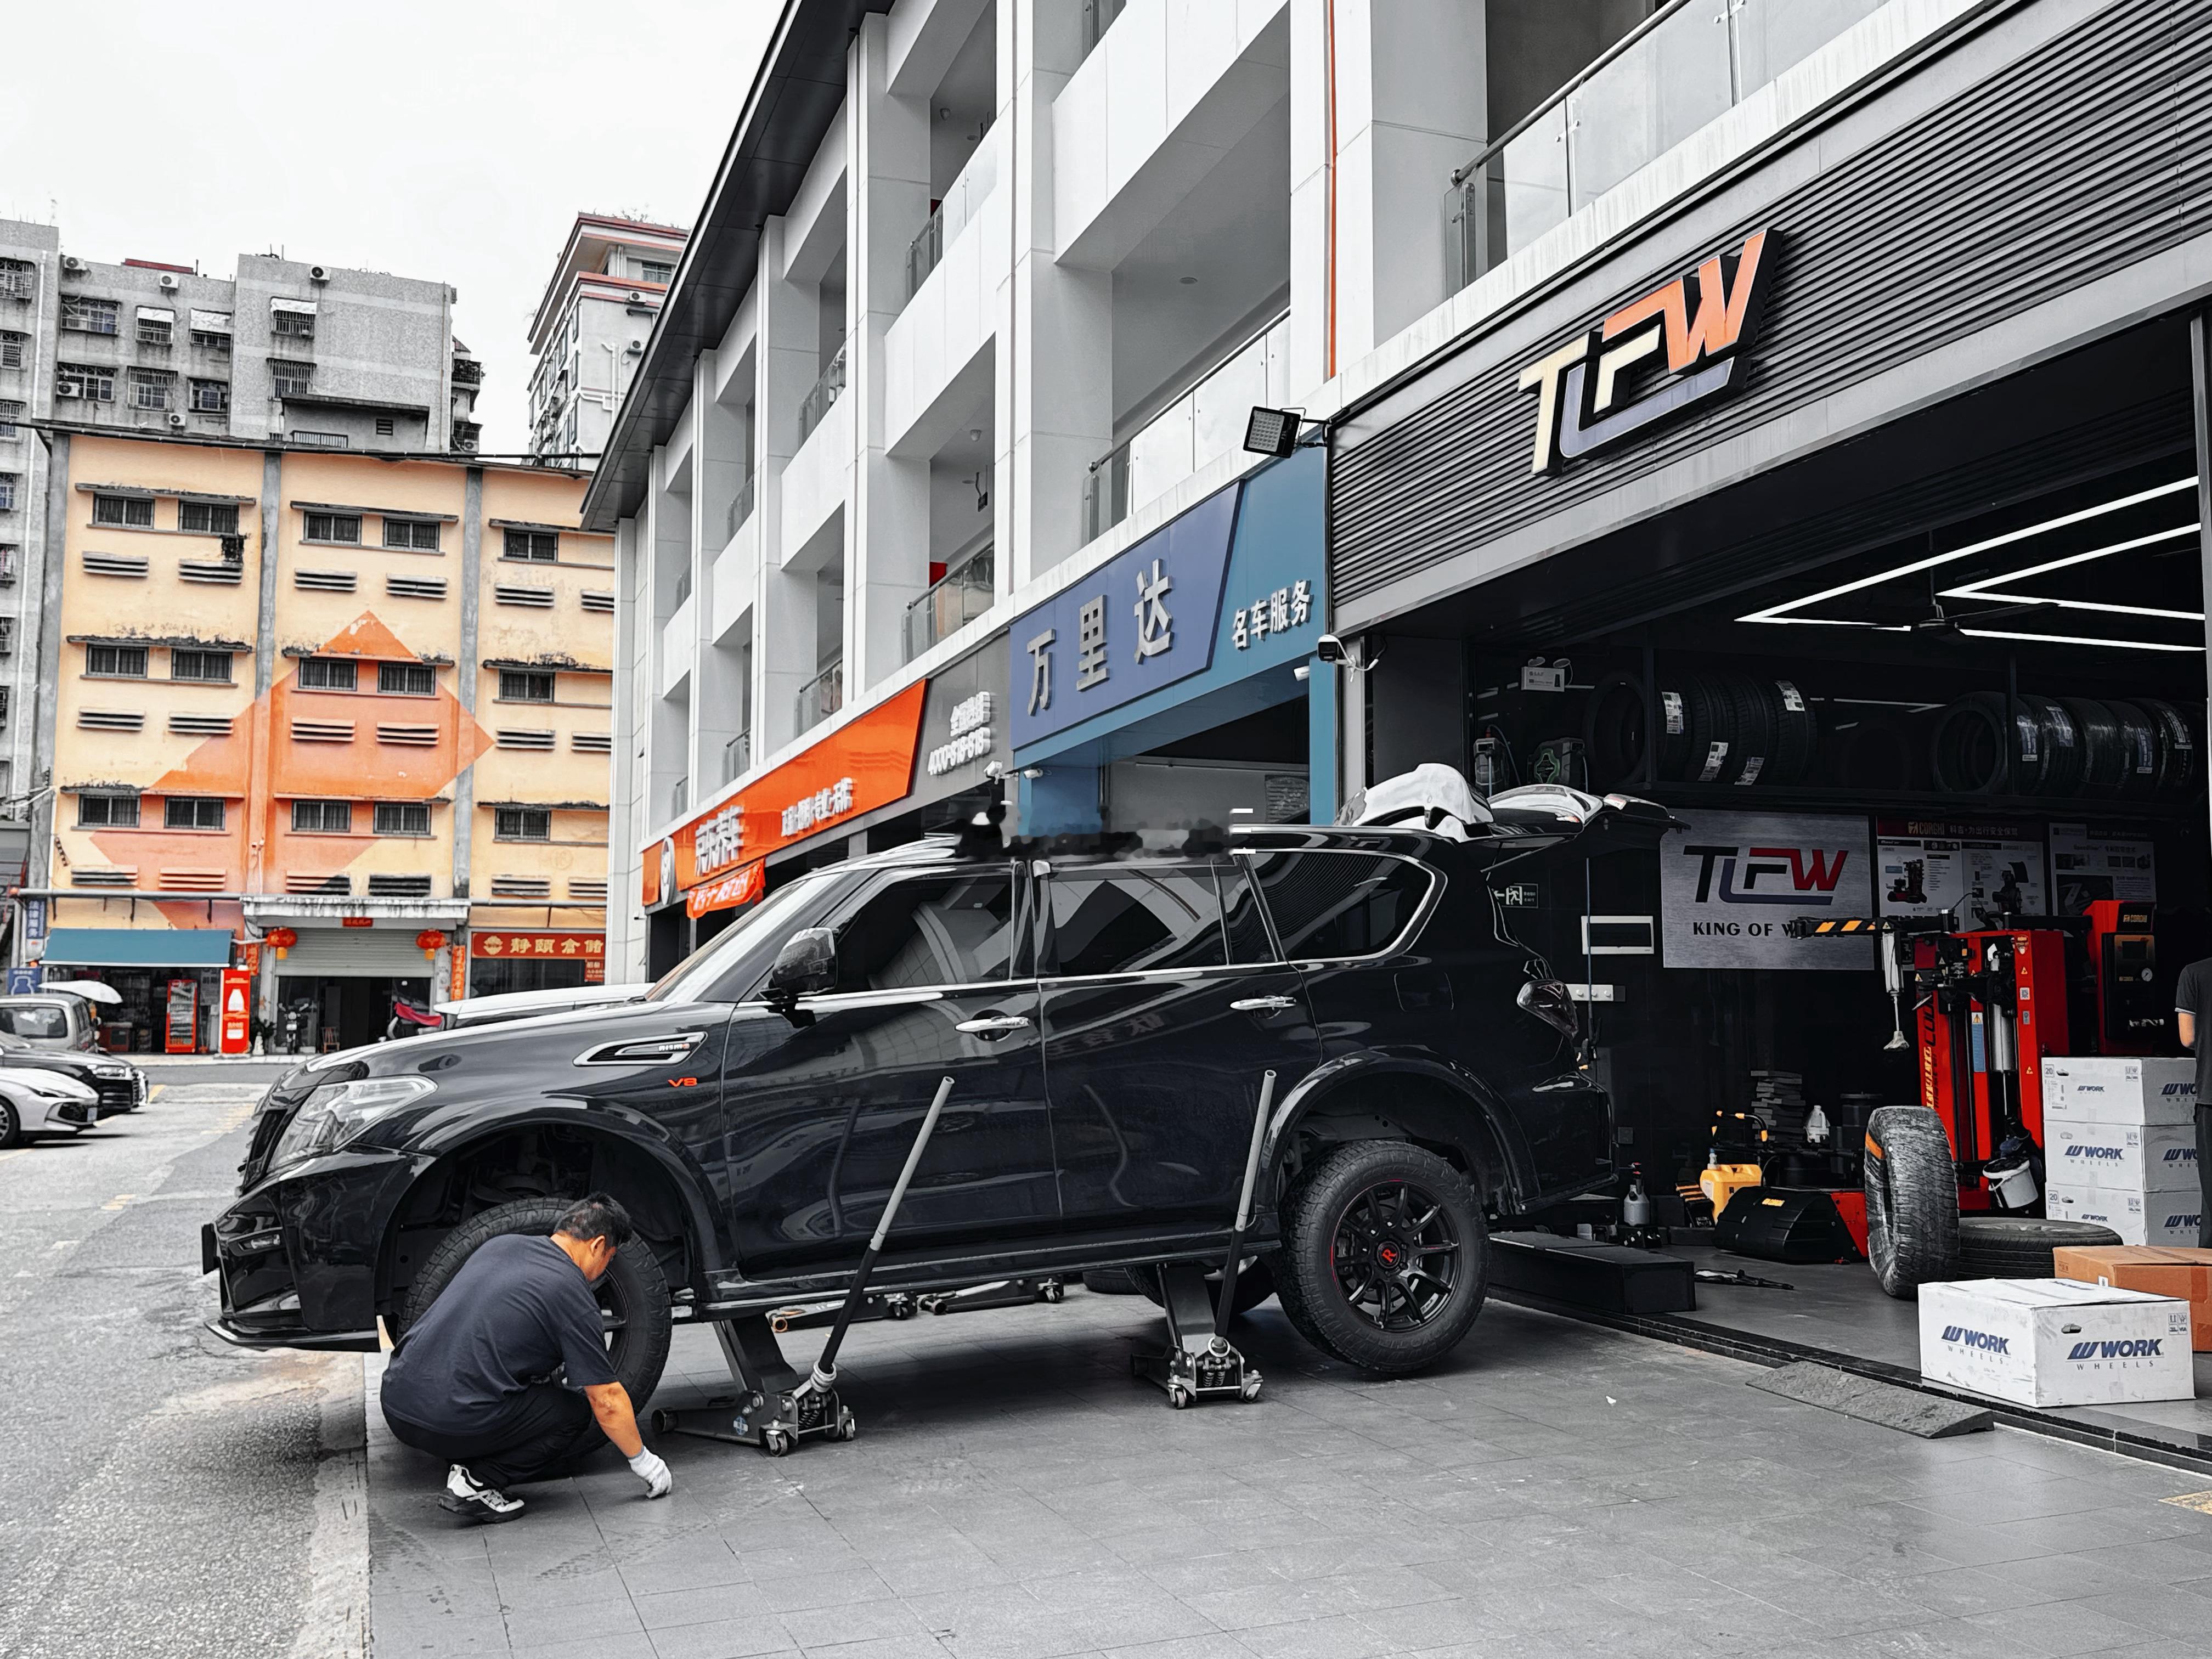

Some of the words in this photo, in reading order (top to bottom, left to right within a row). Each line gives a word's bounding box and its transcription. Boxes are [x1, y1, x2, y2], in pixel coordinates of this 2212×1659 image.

[1232, 579, 1312, 651] 名车服务
[1027, 558, 1173, 716] 万里达
[1693, 922, 1740, 936] KING
[1748, 922, 1773, 936] OF
[668, 1077, 698, 1087] V8
[2180, 1083, 2197, 1095] WO
[2085, 1146, 2123, 1160] WORK
[2049, 1193, 2058, 1201] 20
[2184, 1214, 2202, 1227] WO
[1965, 1329, 2010, 1355] WORK
[2101, 1339, 2163, 1358] WORK
[1948, 1345, 2004, 1365] WHEELS
[2076, 1361, 2154, 1370] WHEELS
